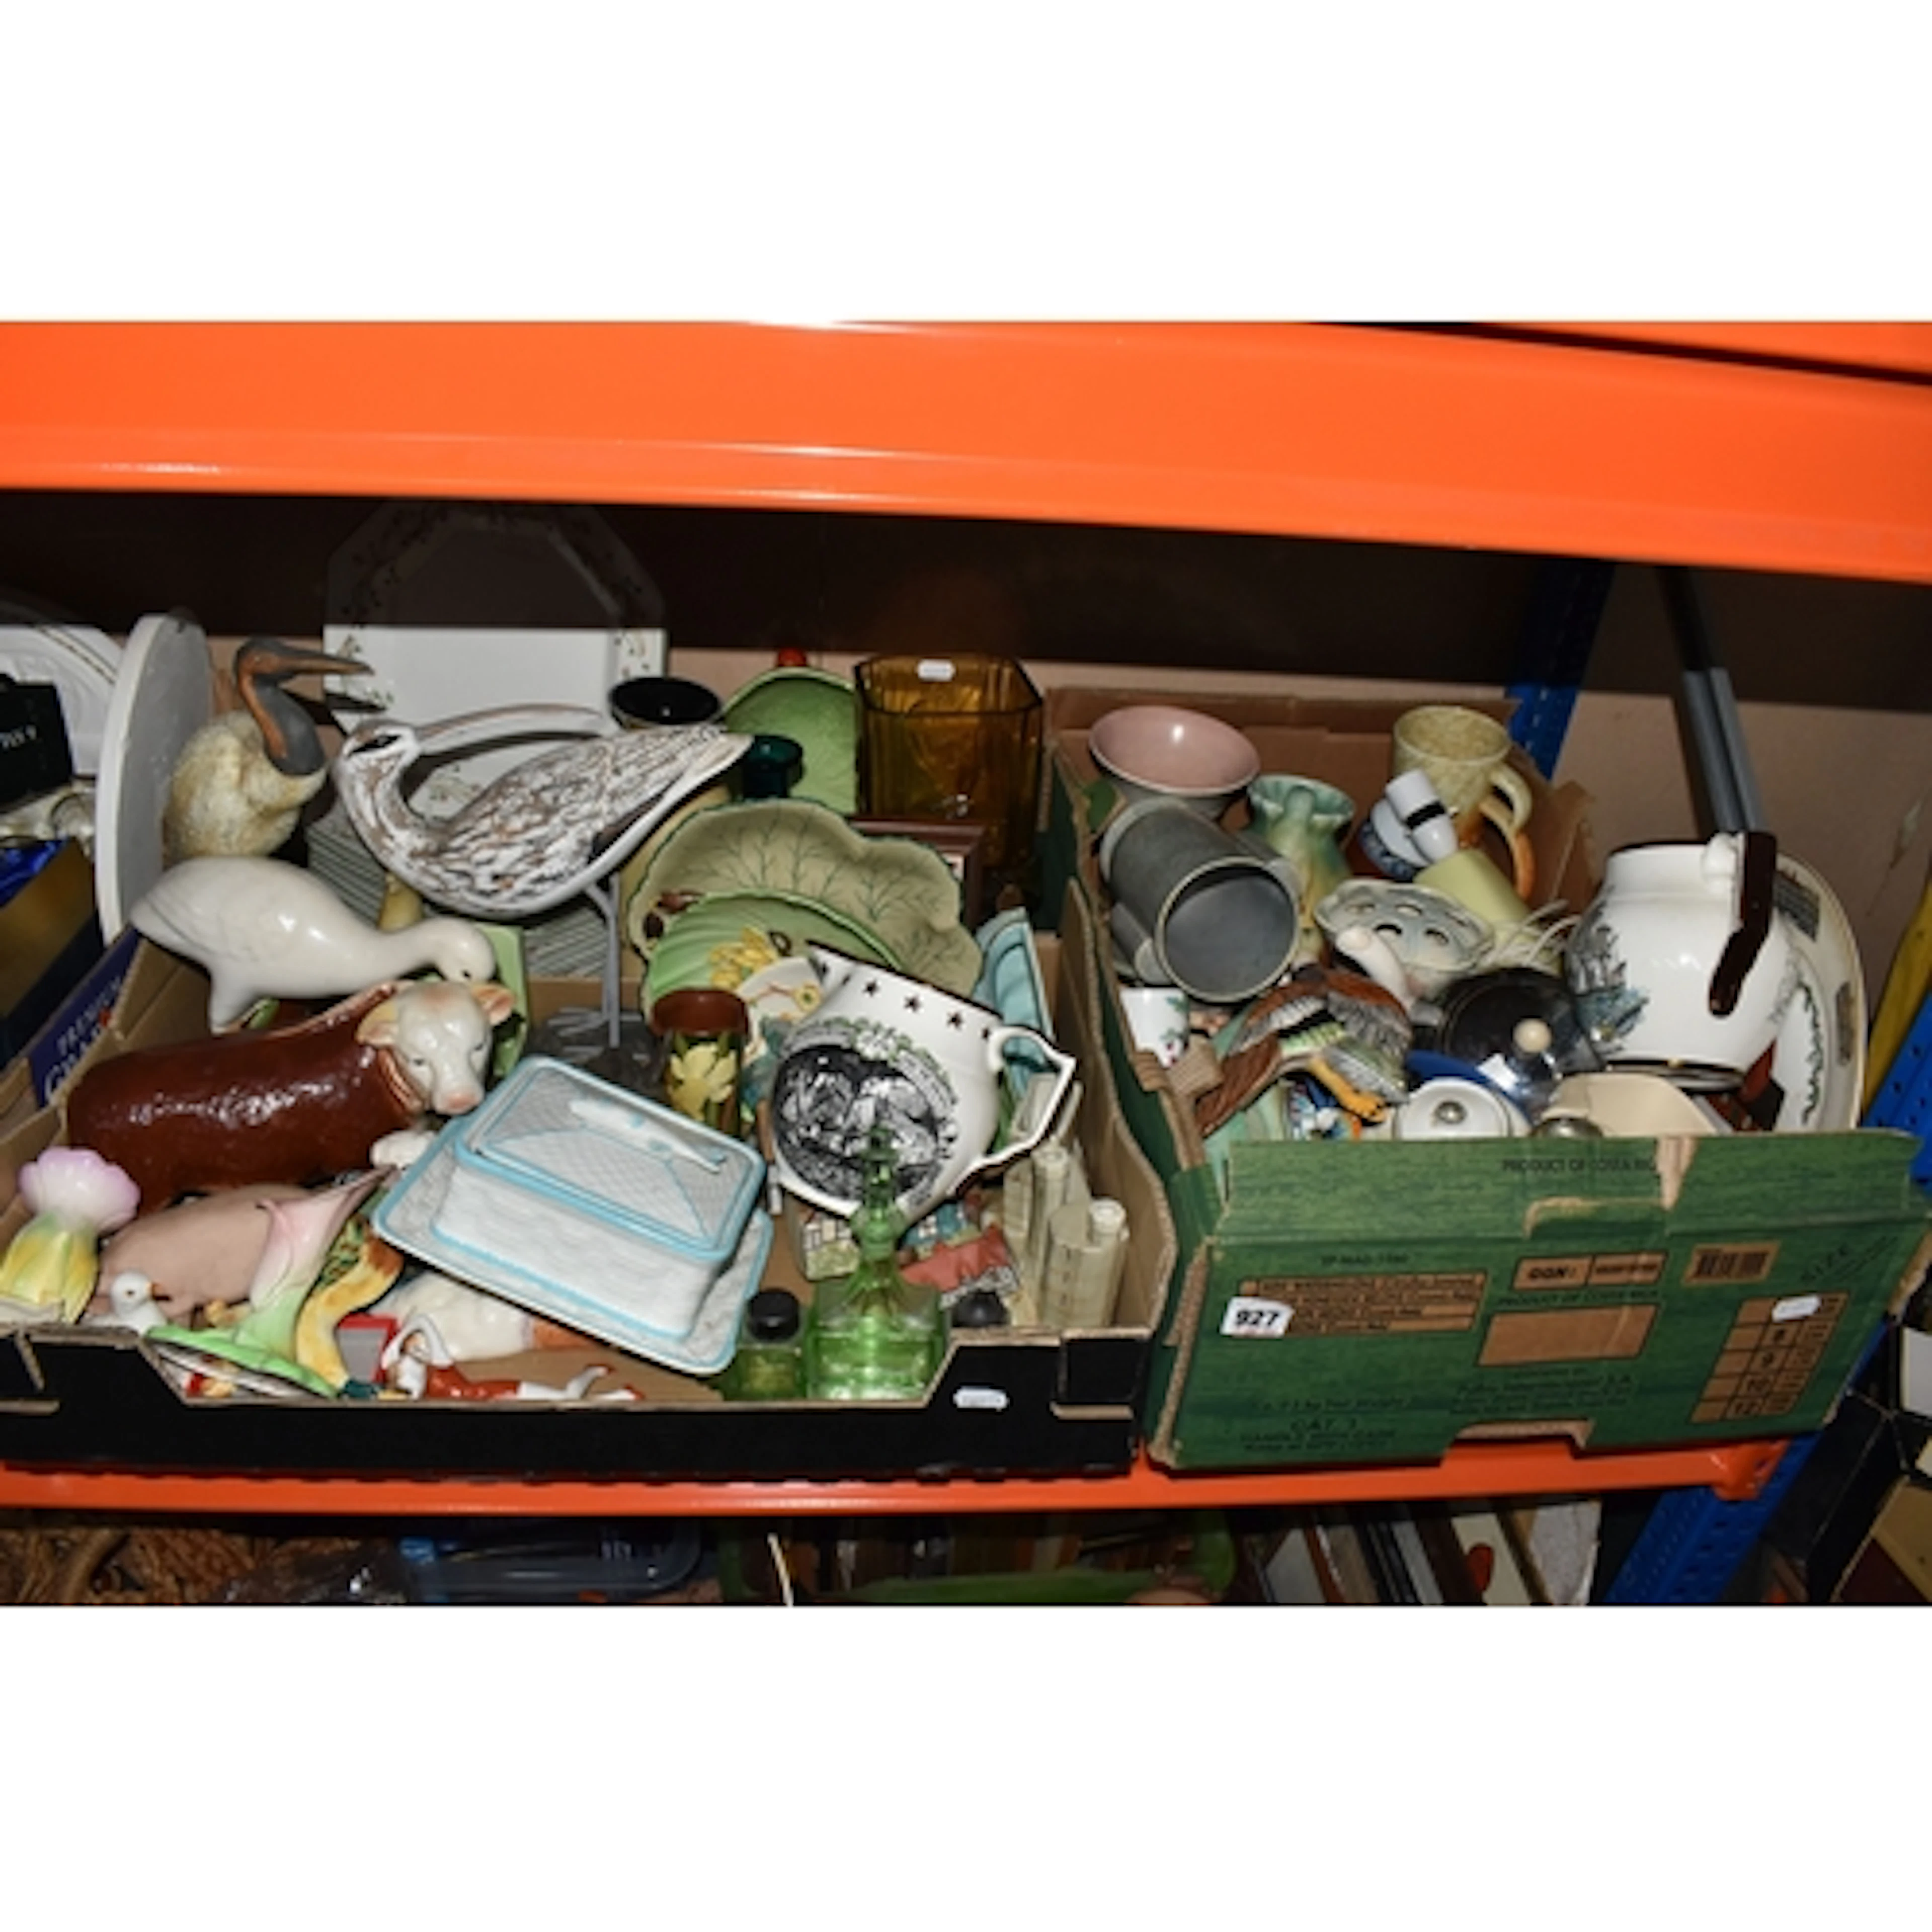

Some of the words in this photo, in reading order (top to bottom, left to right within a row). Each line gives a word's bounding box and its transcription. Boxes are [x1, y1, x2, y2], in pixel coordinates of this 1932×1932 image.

[1503, 1159, 1565, 1172] PRODUCT
[1569, 1159, 1584, 1170] OF
[1237, 1310, 1279, 1326] 927
